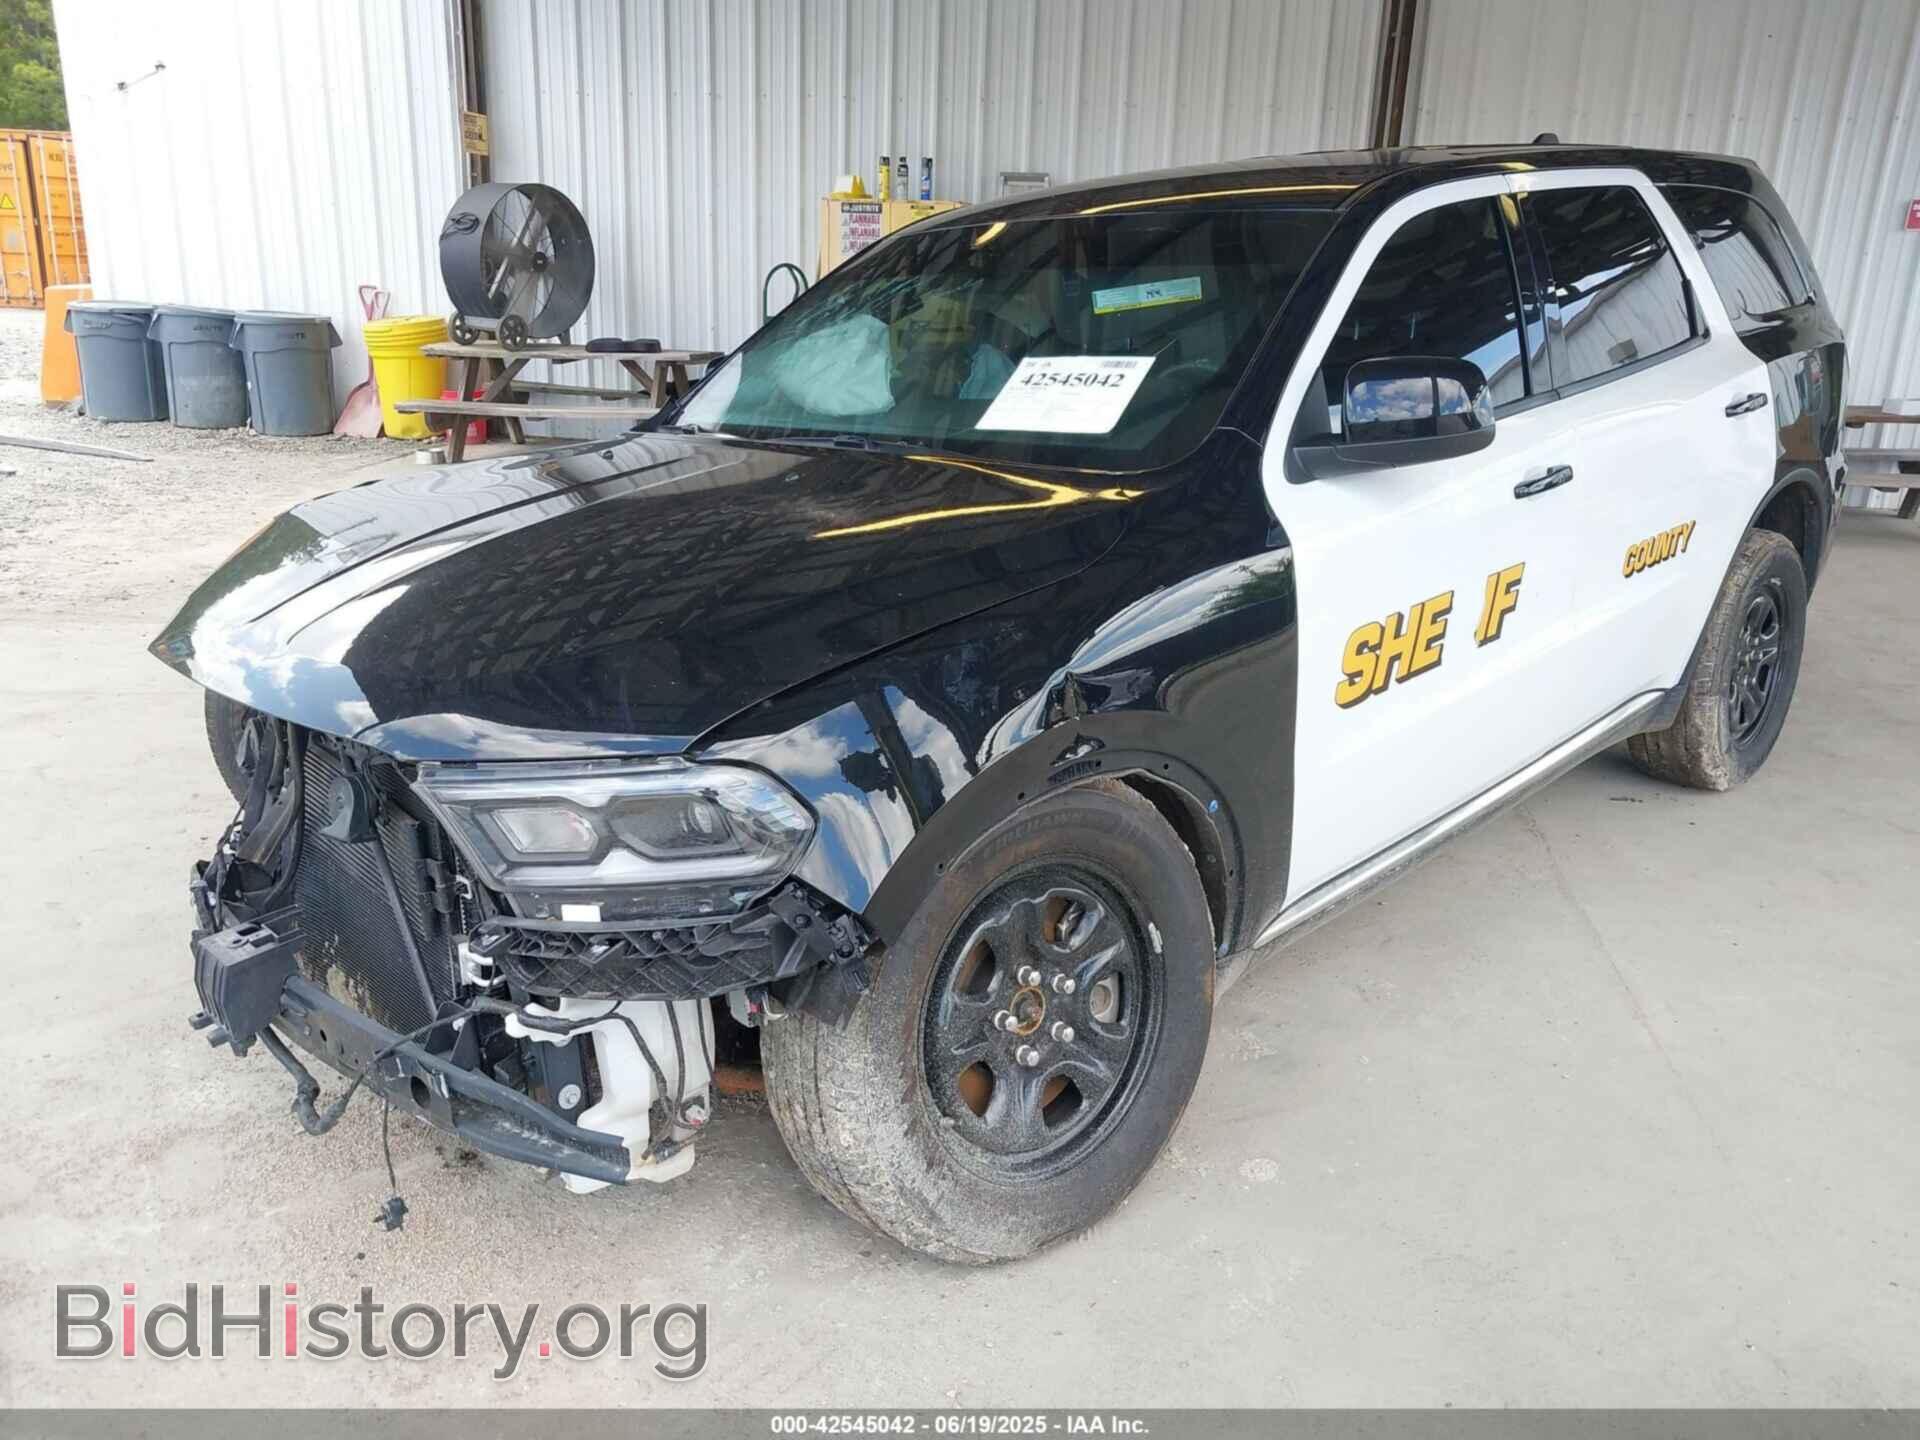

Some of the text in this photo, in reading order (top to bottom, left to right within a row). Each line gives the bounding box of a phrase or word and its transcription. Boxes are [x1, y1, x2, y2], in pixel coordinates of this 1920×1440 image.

[1021, 373, 1126, 388] 42545042
[1621, 520, 1697, 579] COUNTY
[1335, 561, 1526, 709] SHE IF
